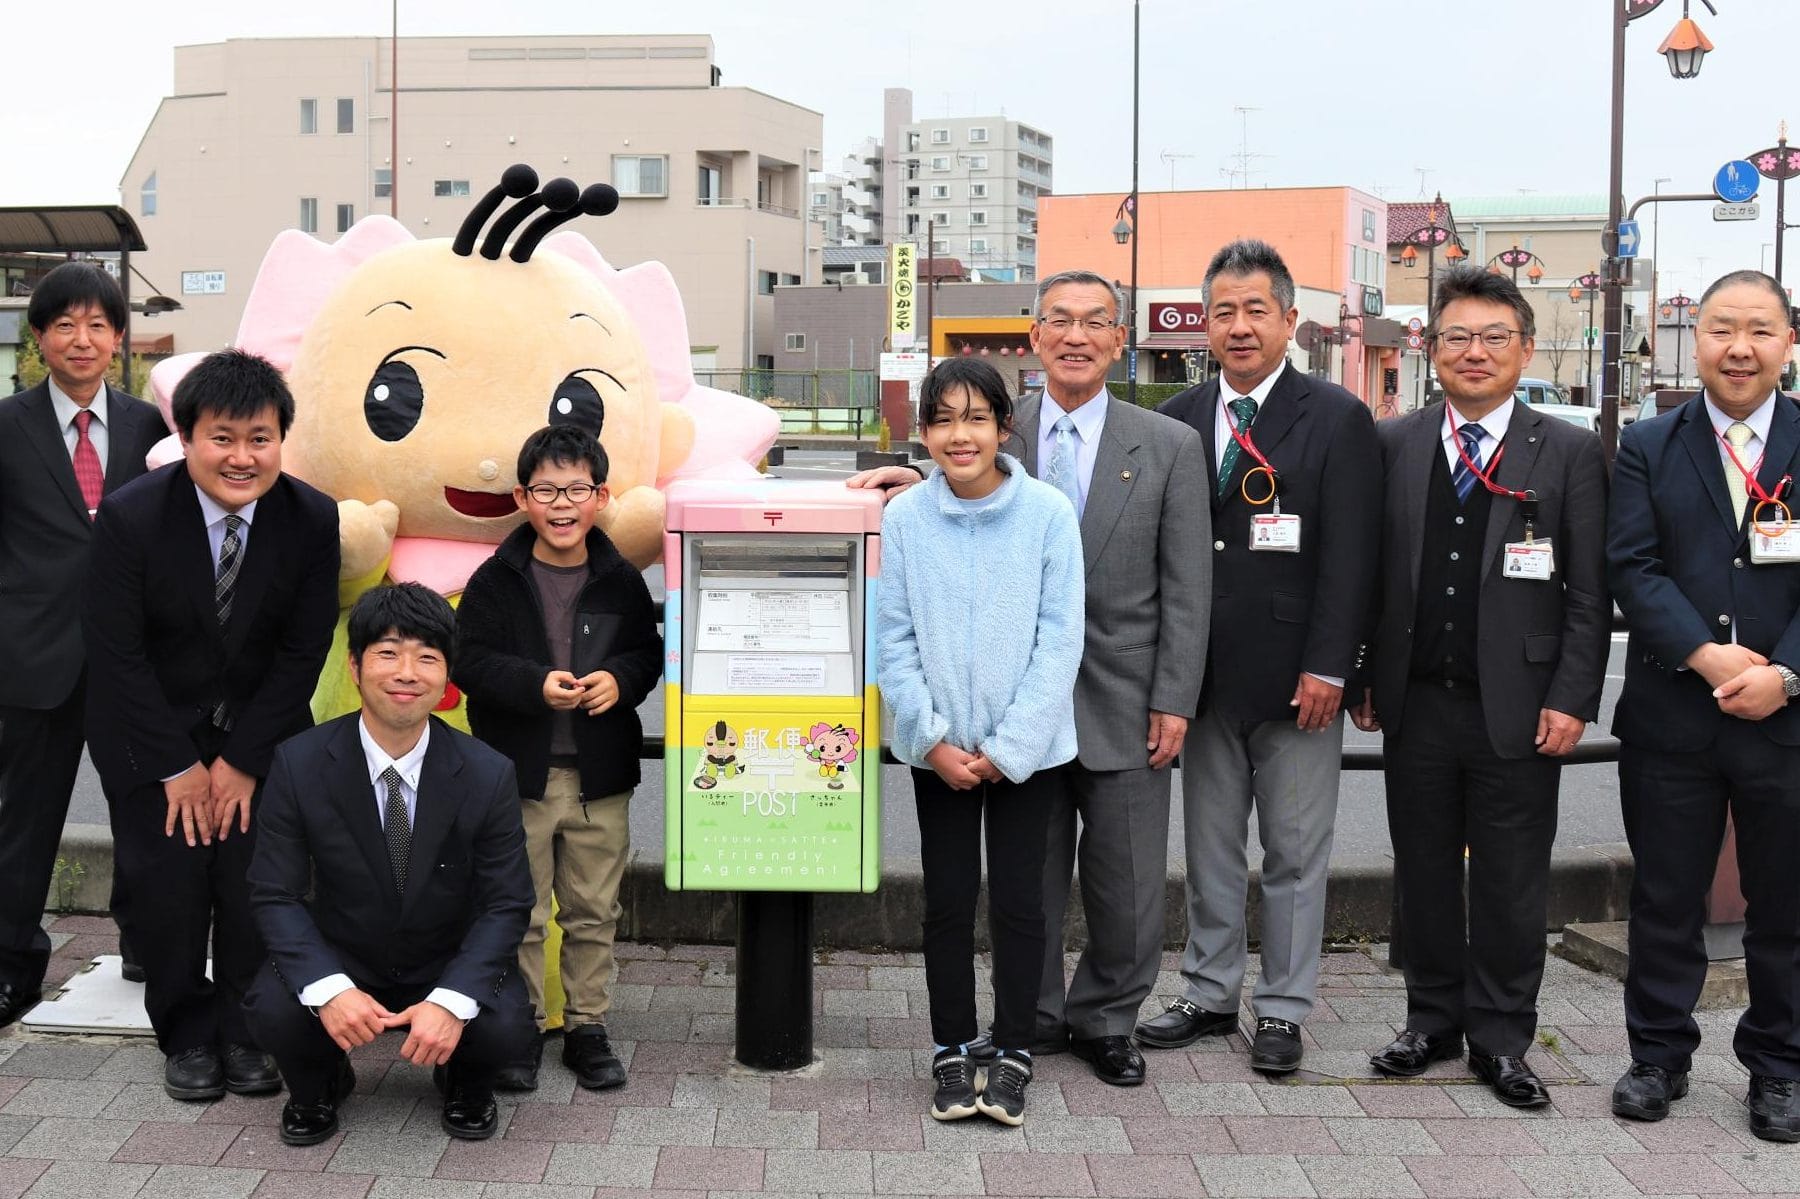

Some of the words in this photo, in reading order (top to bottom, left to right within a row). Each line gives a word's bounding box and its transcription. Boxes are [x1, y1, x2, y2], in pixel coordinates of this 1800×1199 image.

[1719, 206, 1756, 216] ここから
[896, 299, 911, 331] かごや
[743, 727, 803, 760] 郵便
[743, 789, 798, 817] POST
[718, 849, 823, 863] Friendly
[702, 864, 837, 876] Agreement
